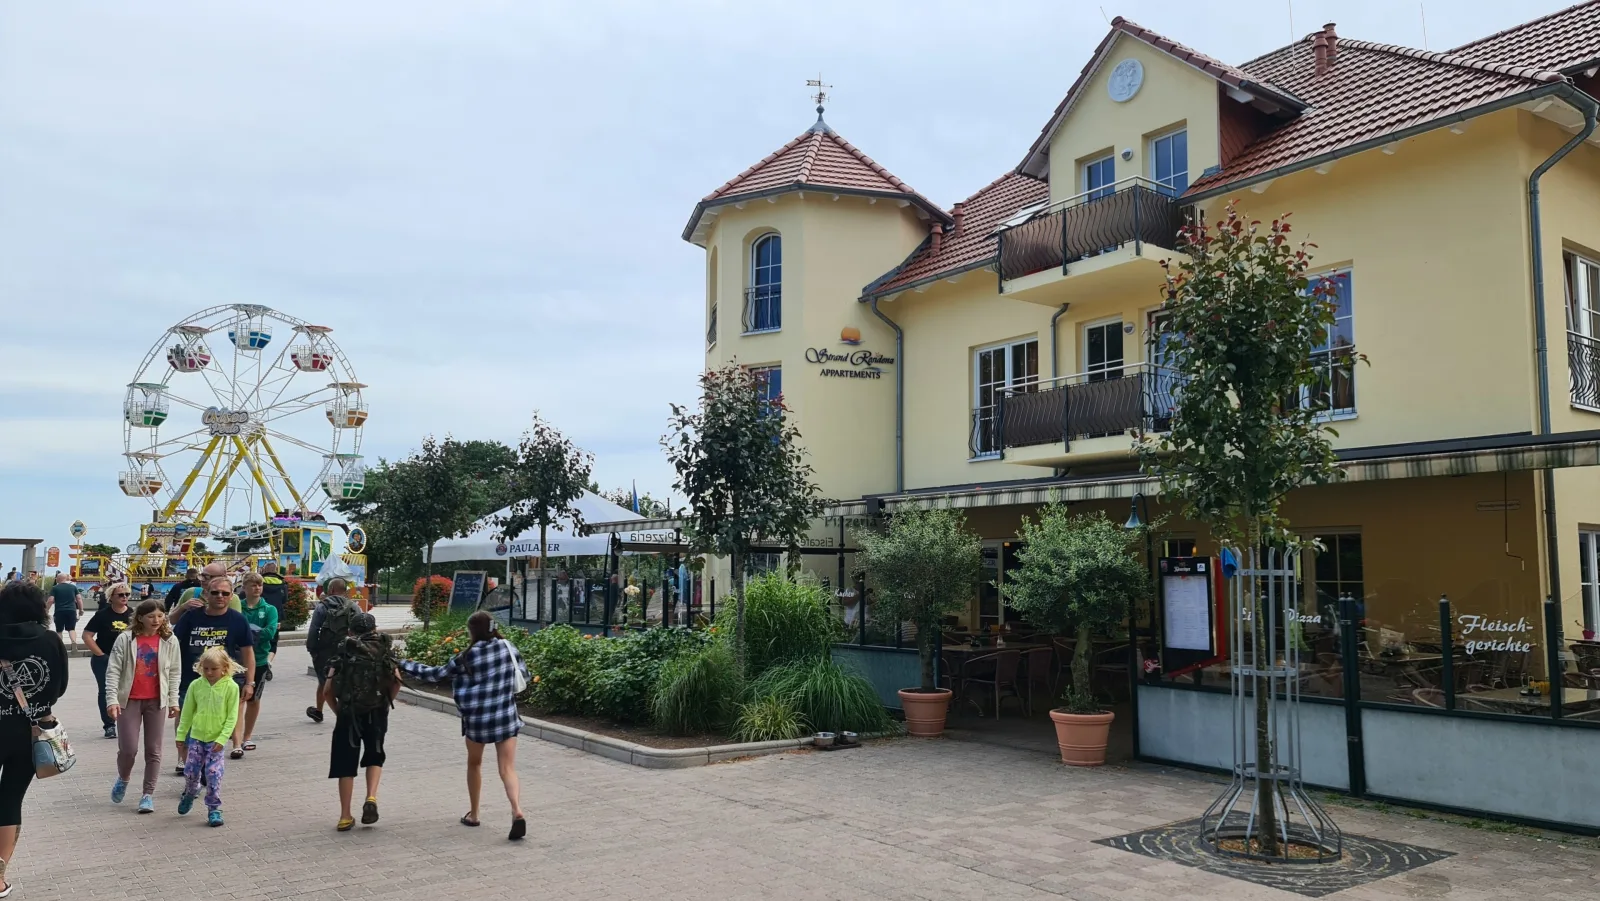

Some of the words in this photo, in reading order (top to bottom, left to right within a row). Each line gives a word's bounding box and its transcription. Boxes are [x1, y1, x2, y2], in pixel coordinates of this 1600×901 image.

[805, 347, 849, 364] Strand
[820, 368, 881, 379] APPARTEMENTS
[825, 516, 877, 528] Pizeria
[509, 543, 560, 553] PAULAER
[1457, 614, 1534, 635] Fleisch-
[1465, 636, 1531, 655] gerichte
